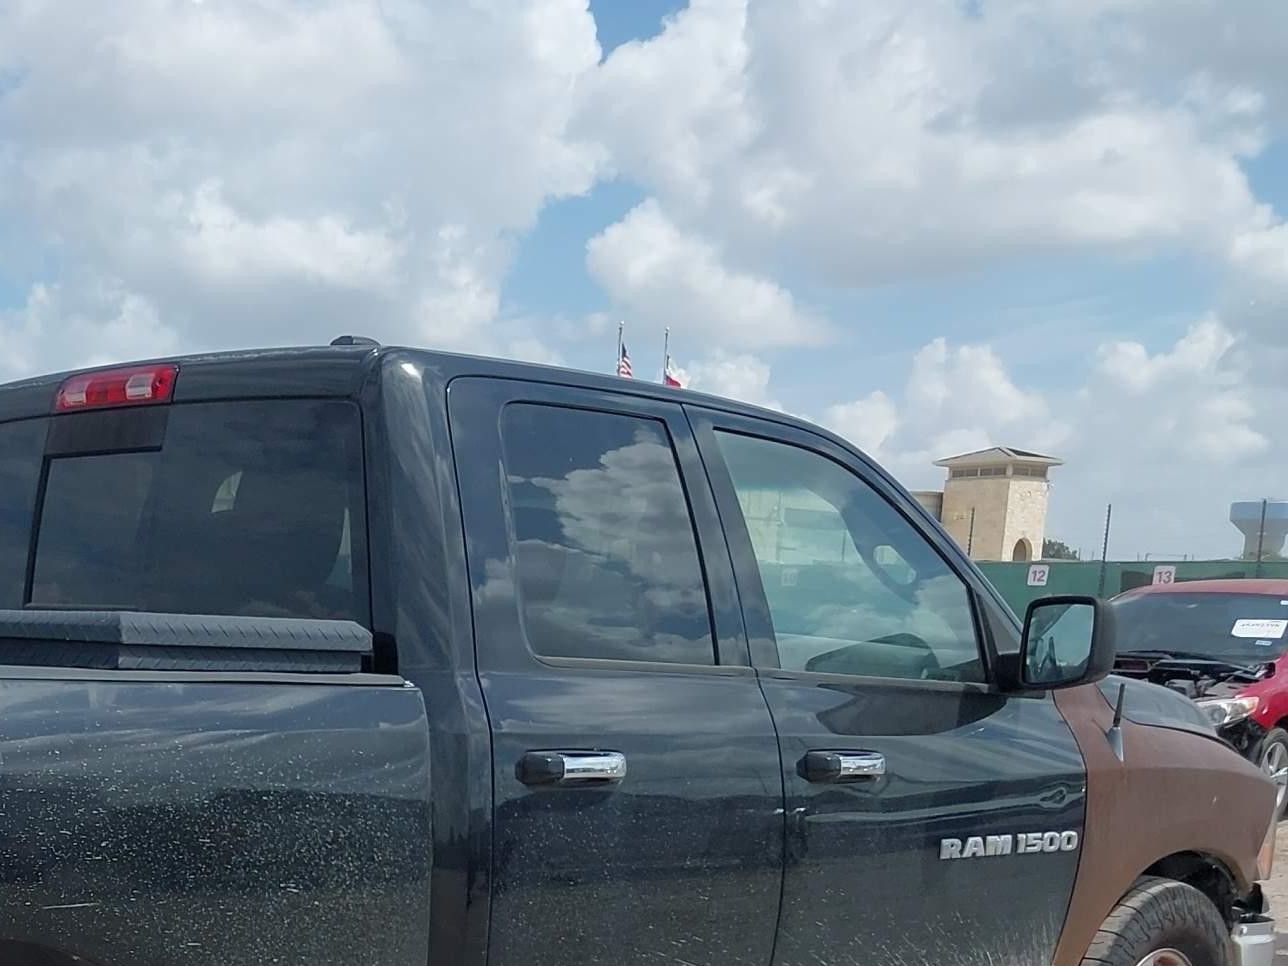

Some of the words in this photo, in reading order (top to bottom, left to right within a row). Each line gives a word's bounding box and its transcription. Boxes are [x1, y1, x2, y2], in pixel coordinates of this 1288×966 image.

[1031, 569, 1046, 582] 12
[1157, 571, 1172, 584] 13
[939, 834, 1012, 860] RAM
[1016, 830, 1078, 854] 1500
